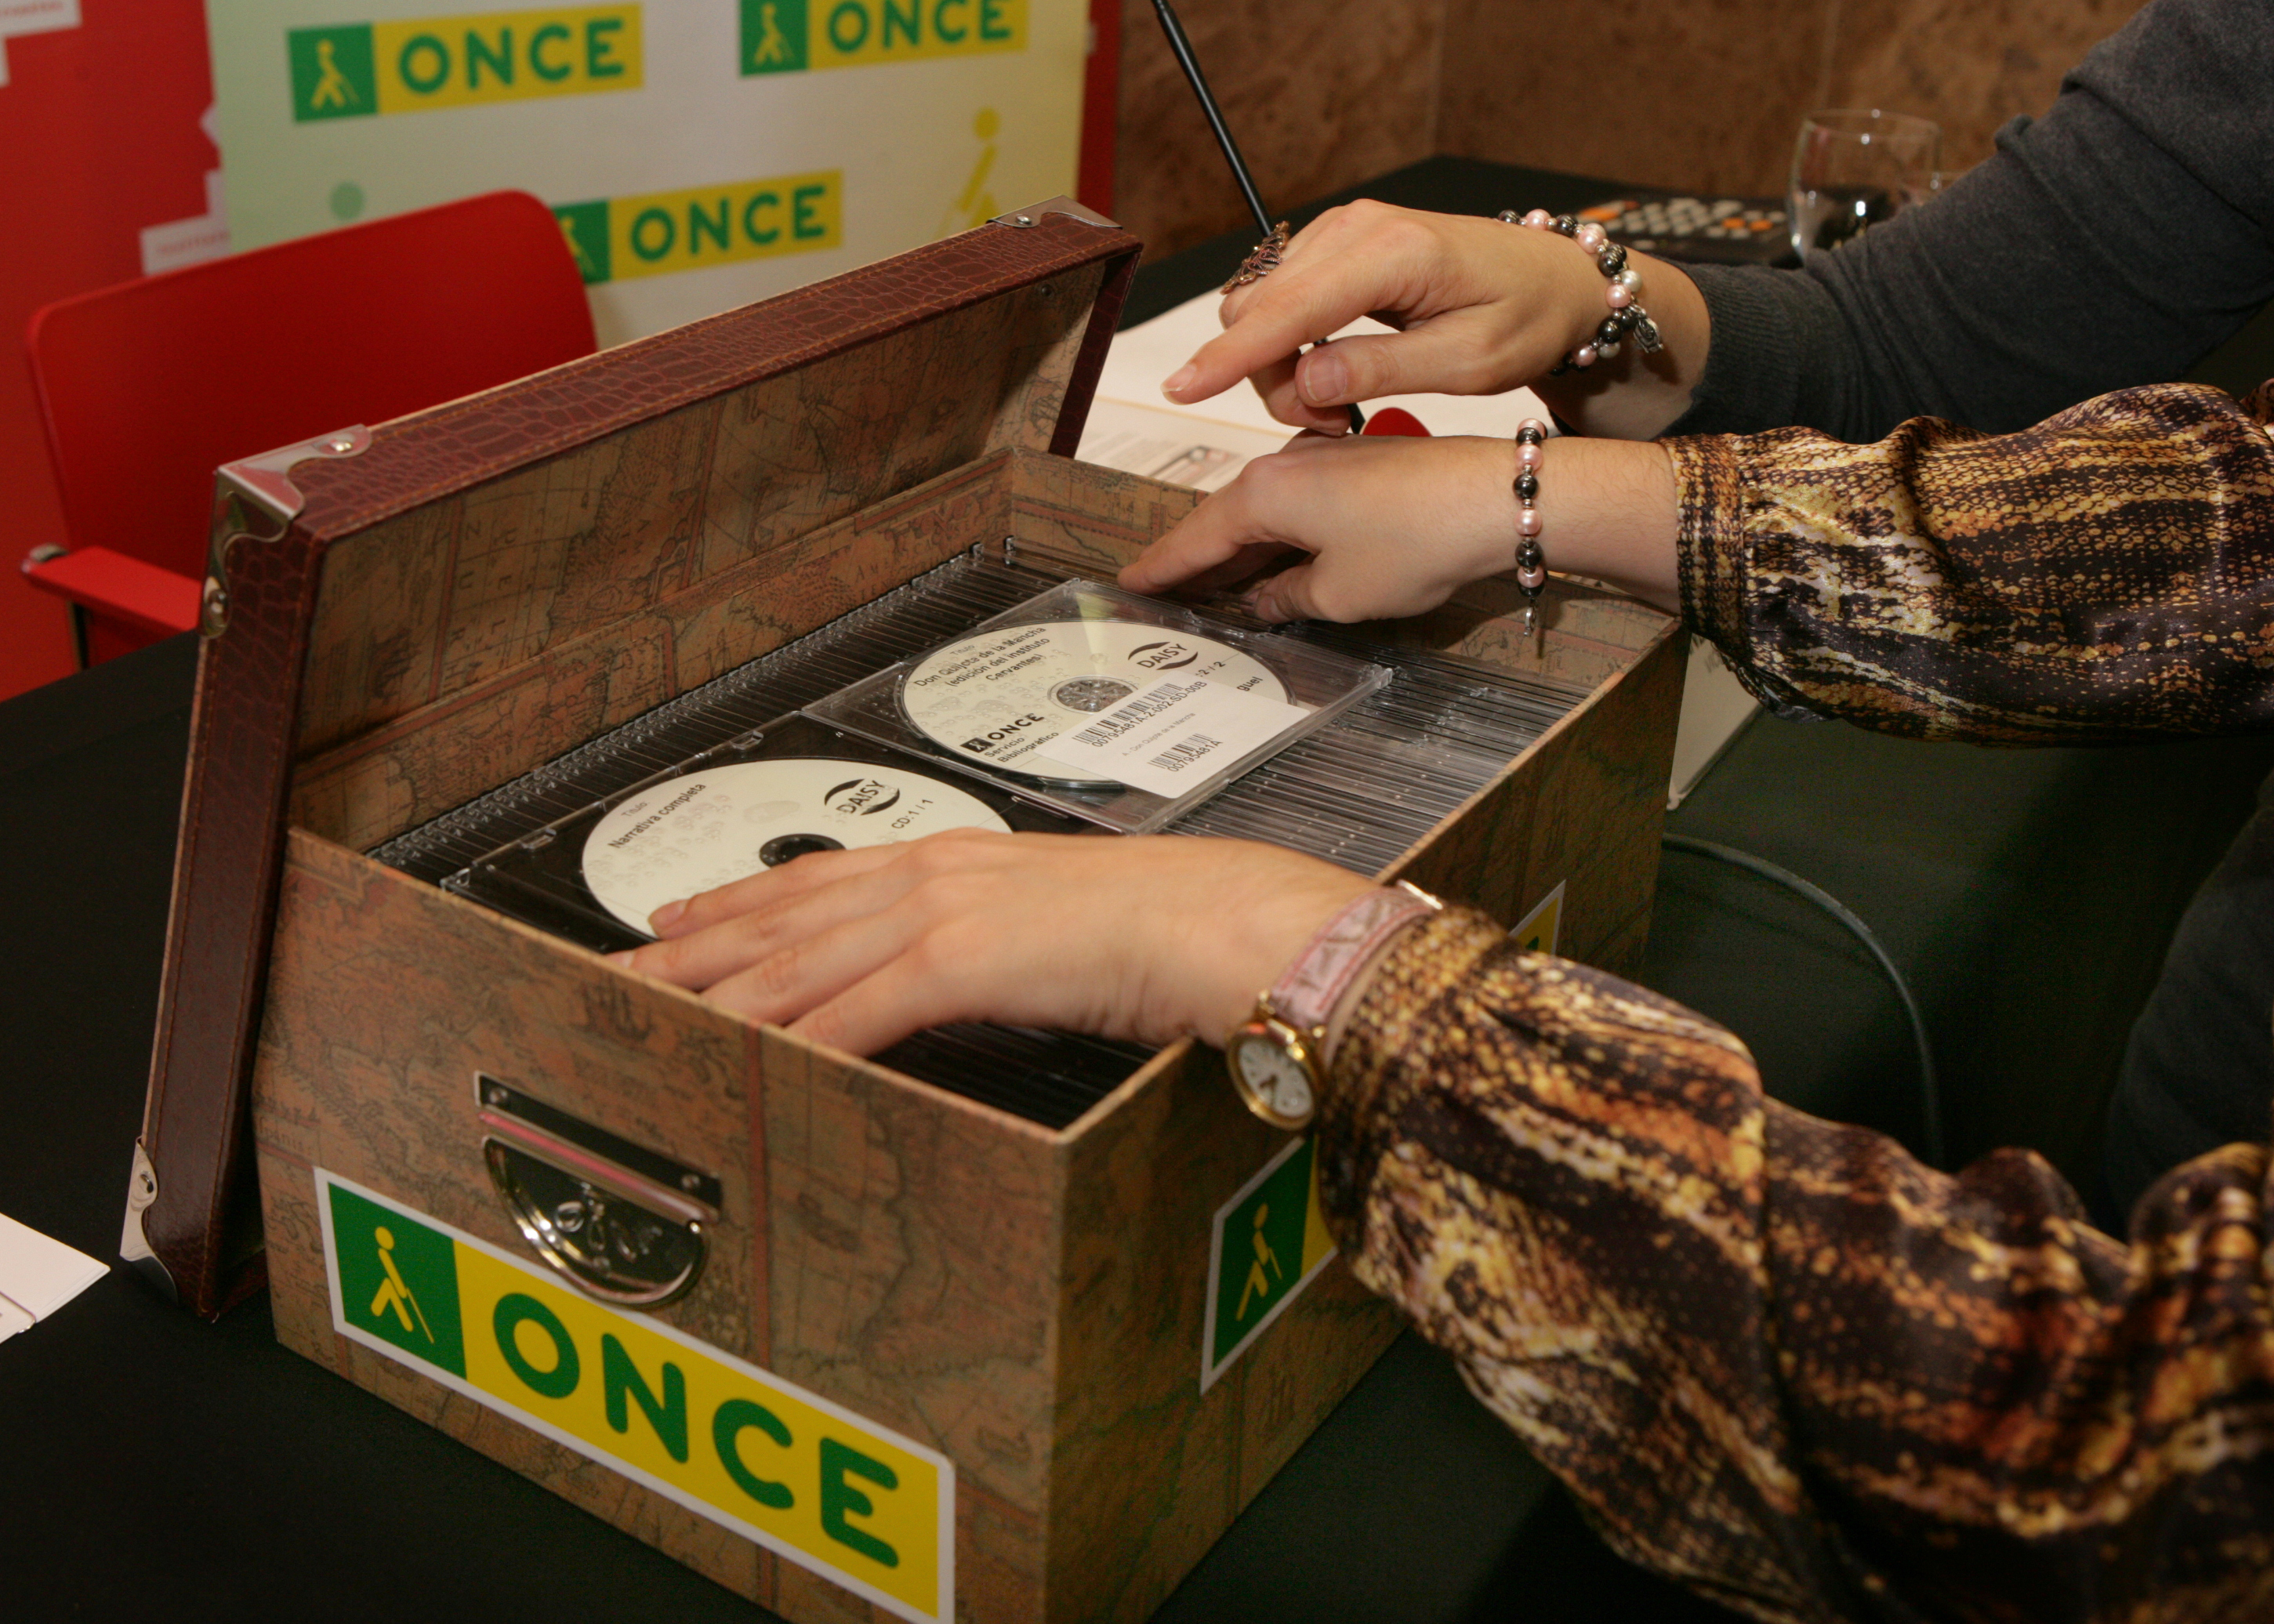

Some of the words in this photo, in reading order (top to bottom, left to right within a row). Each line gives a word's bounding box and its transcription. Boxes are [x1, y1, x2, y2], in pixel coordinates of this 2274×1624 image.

[827, 0, 1012, 53] ONCE
[399, 18, 623, 94] ONCE
[630, 185, 825, 262] ONCE
[913, 674, 941, 687] Don
[978, 648, 995, 658] de
[1003, 627, 1046, 647] Mancha
[945, 665, 991, 687] (edición
[989, 656, 1008, 667] del
[1006, 638, 1050, 659] instituto
[985, 654, 1047, 681] Cervantes)
[1137, 643, 1188, 668] DAISY
[987, 712, 1045, 740] ONCE
[985, 737, 1025, 757] Servicio
[997, 732, 1059, 763] Bibliográfico
[1166, 739, 1224, 773] 00795481A
[836, 780, 885, 814] DAISY
[607, 815, 662, 849] Narrativa
[658, 784, 706, 816] completa
[891, 810, 919, 829] CD:1
[492, 1292, 899, 1568] ONCE
